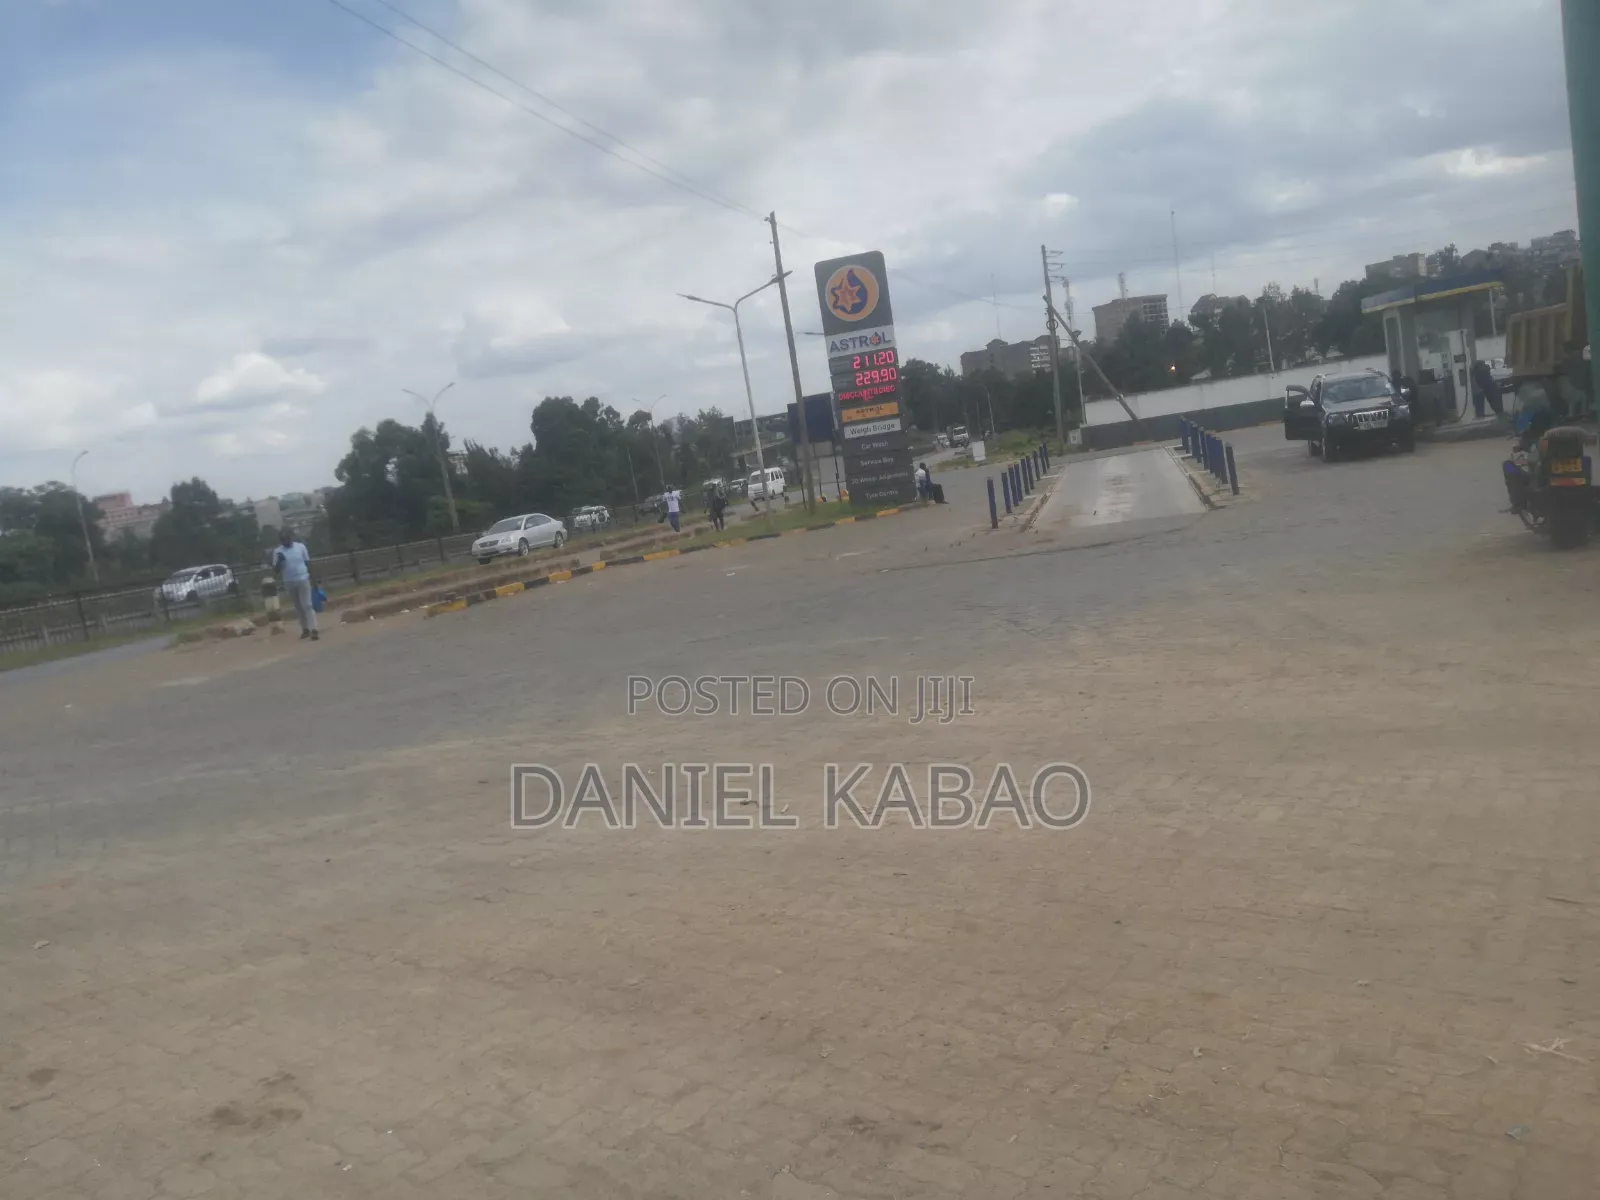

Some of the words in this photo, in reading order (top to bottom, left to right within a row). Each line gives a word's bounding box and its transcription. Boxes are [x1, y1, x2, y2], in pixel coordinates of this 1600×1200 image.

[829, 331, 892, 354] ASTROL
[855, 367, 897, 386] 229.90
[850, 427, 872, 435] Weigh
[873, 423, 895, 432] Bridge
